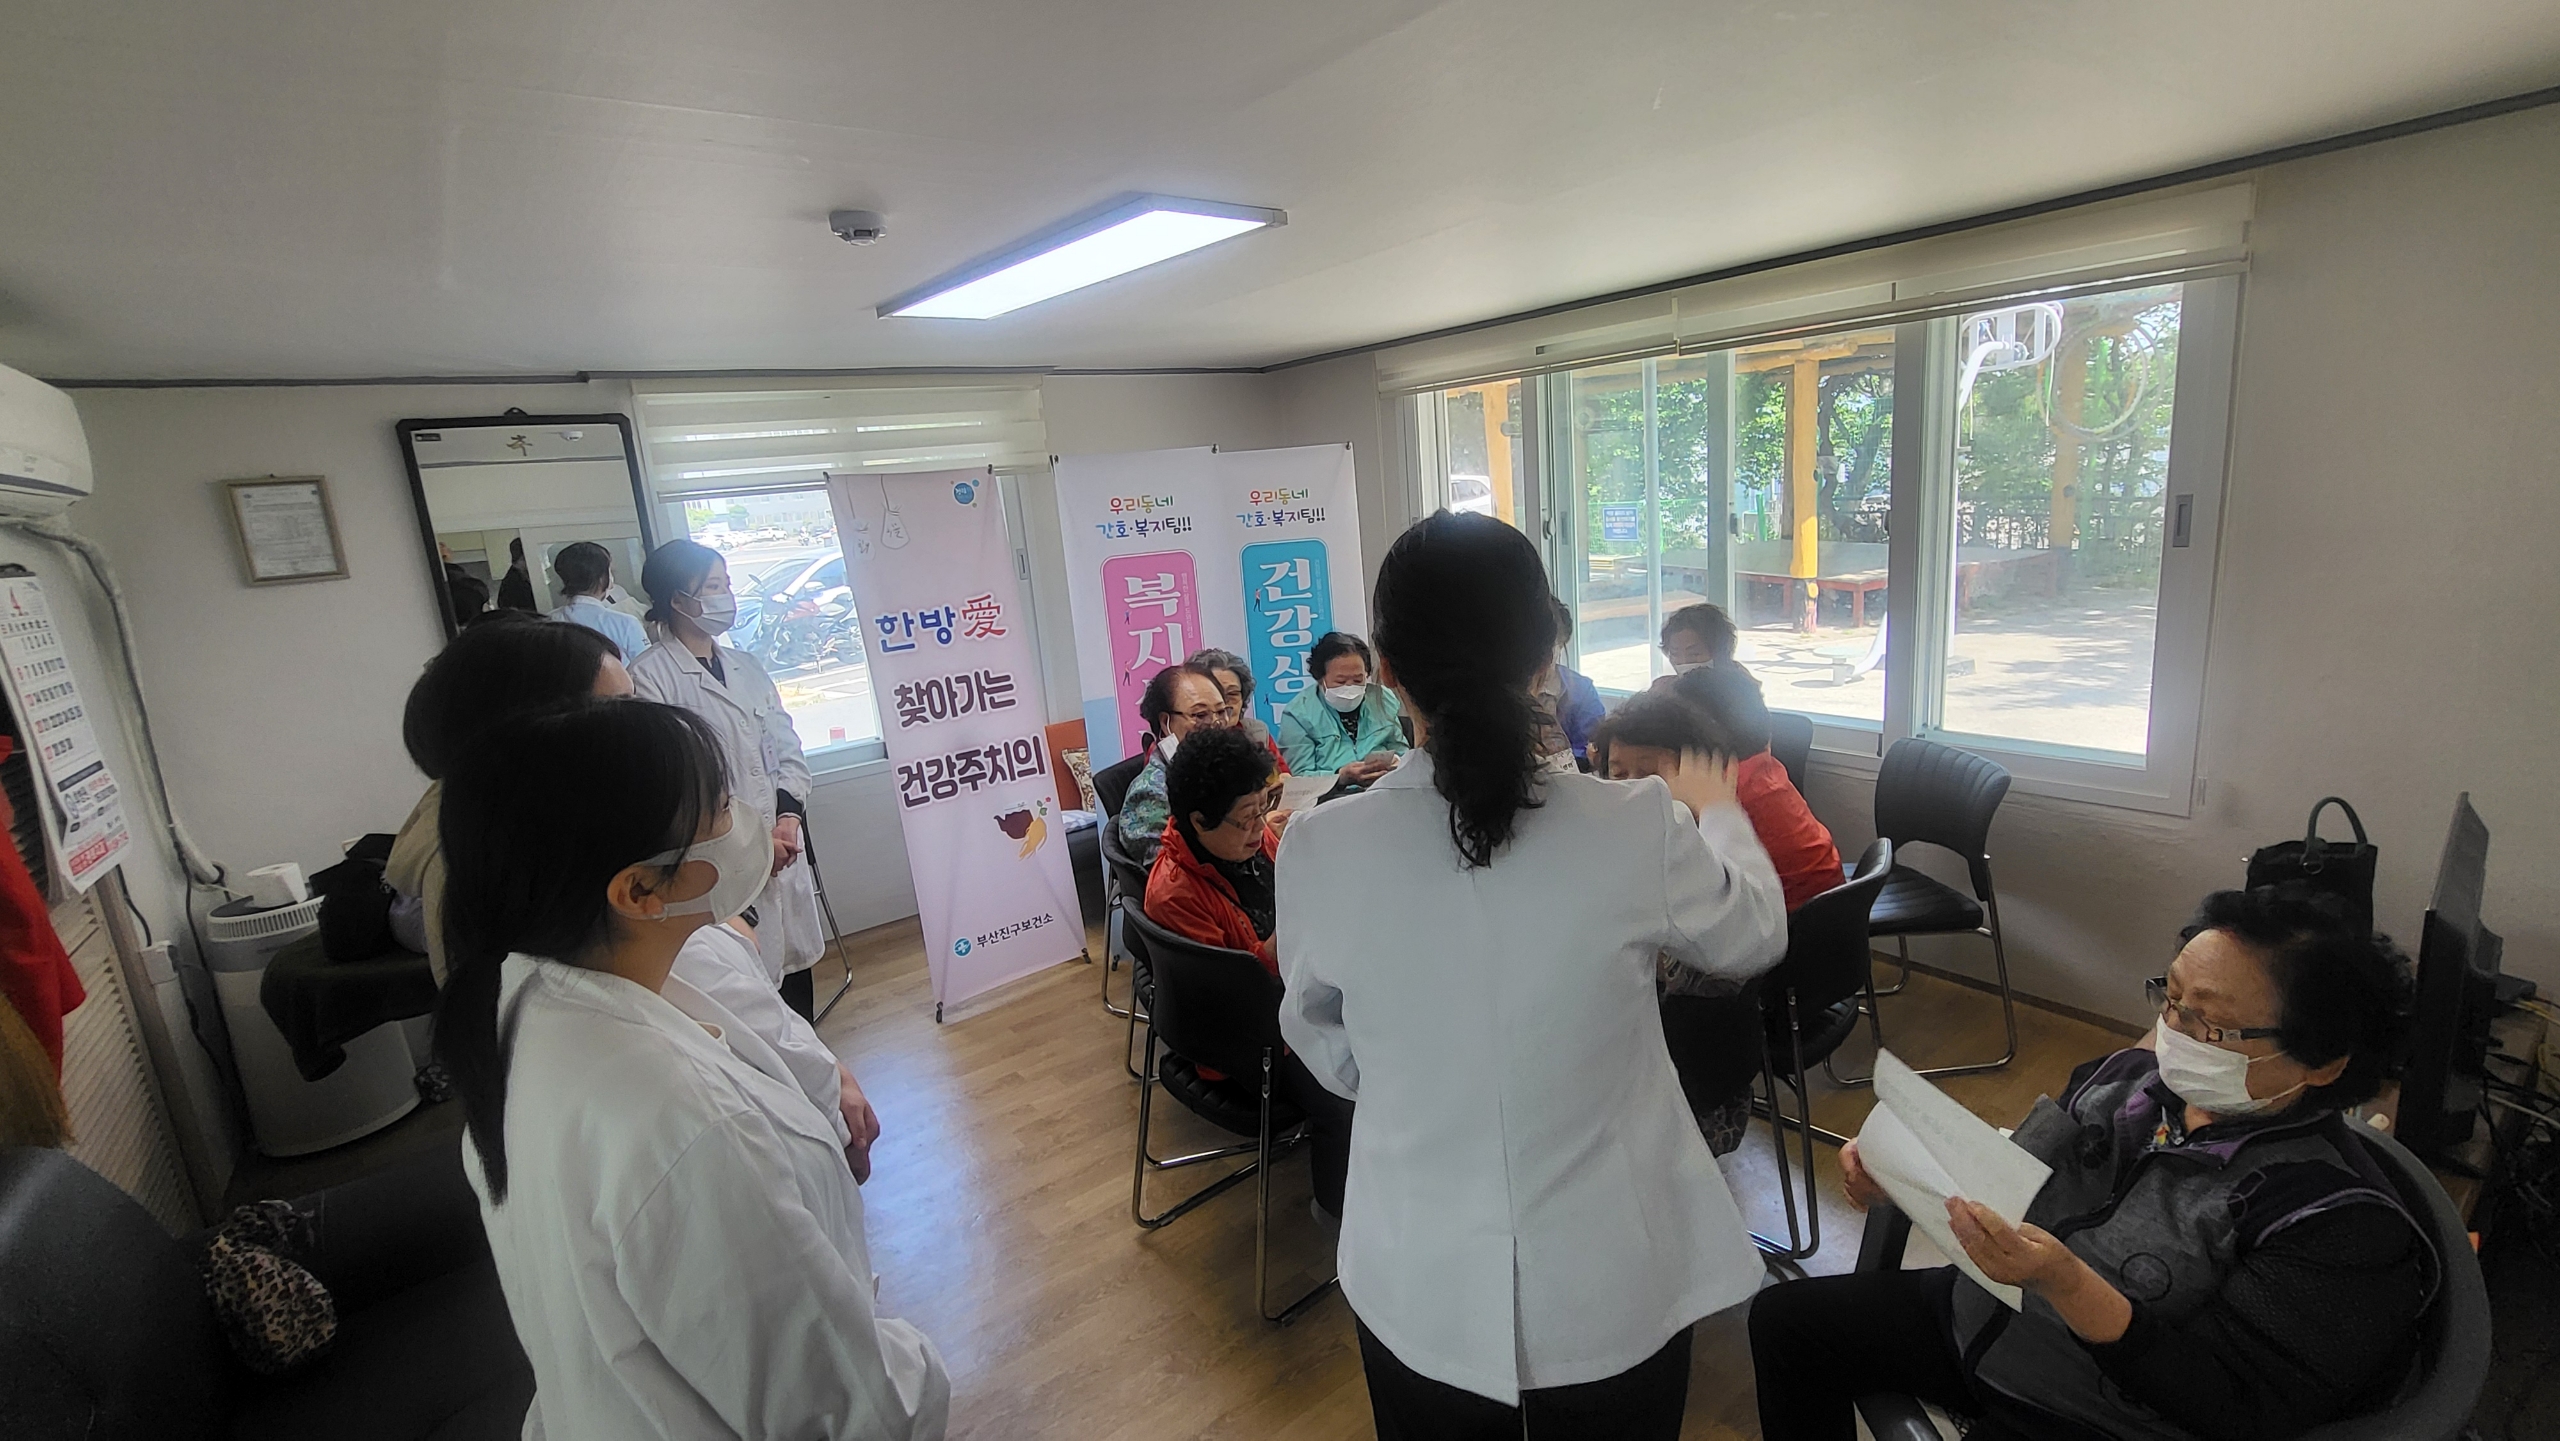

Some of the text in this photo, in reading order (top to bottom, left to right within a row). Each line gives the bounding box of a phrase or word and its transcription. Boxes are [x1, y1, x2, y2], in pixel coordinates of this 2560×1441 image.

[1110, 495, 1174, 515] 우리동네
[1250, 488, 1309, 506] 우리동네
[1095, 516, 1193, 539] 간호·복지팀!!
[1237, 507, 1326, 528] 간호·복지팀!!
[875, 594, 1007, 653] 한방愛
[893, 669, 1017, 728] 찾아가는
[897, 735, 1047, 809] 건강주치의
[976, 912, 1055, 949] 부산진구보건소
